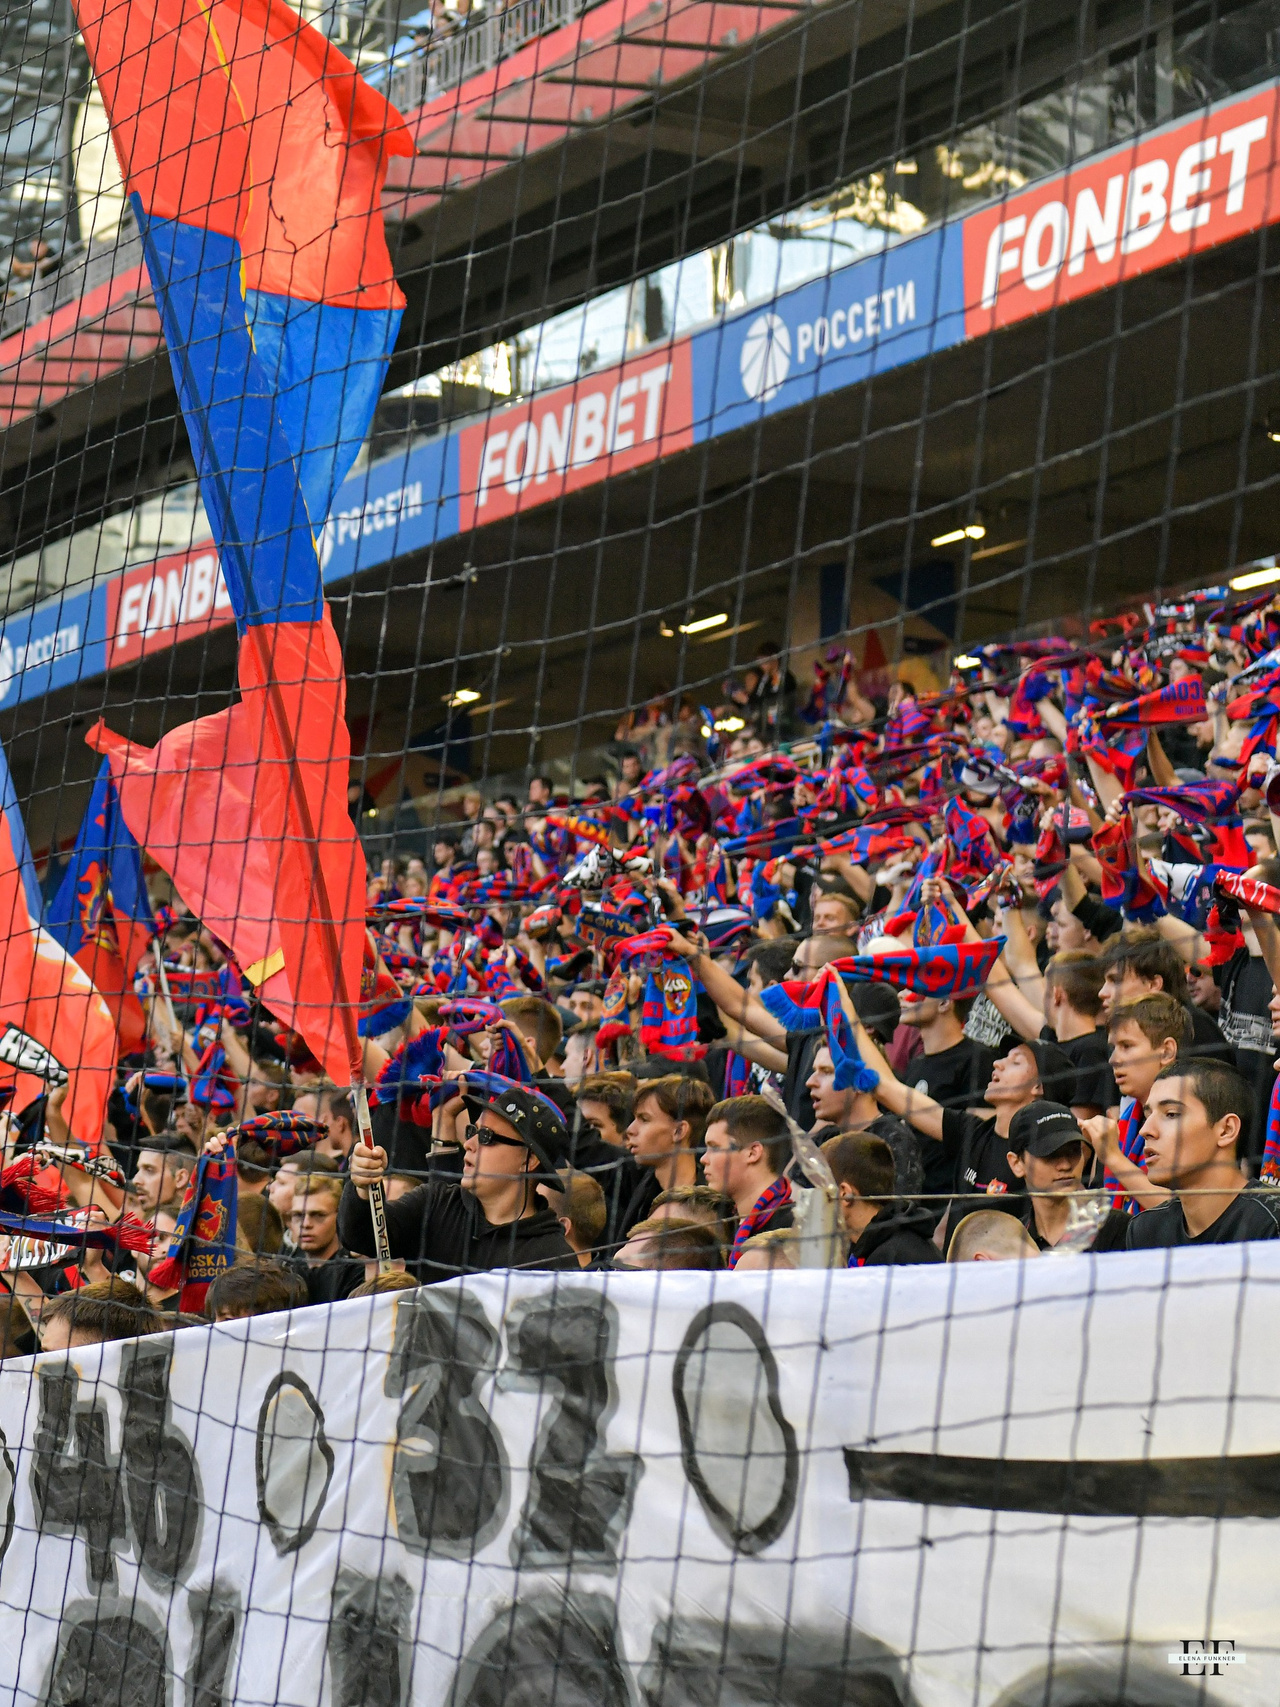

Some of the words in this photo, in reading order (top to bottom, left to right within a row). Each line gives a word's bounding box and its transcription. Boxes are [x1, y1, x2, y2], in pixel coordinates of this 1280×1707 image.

[982, 116, 1268, 310] FONBET
[797, 280, 916, 364] РОССЕТИ
[475, 363, 673, 508] FONBET
[337, 480, 423, 546] РОССЕТИ
[117, 554, 232, 648] FONB
